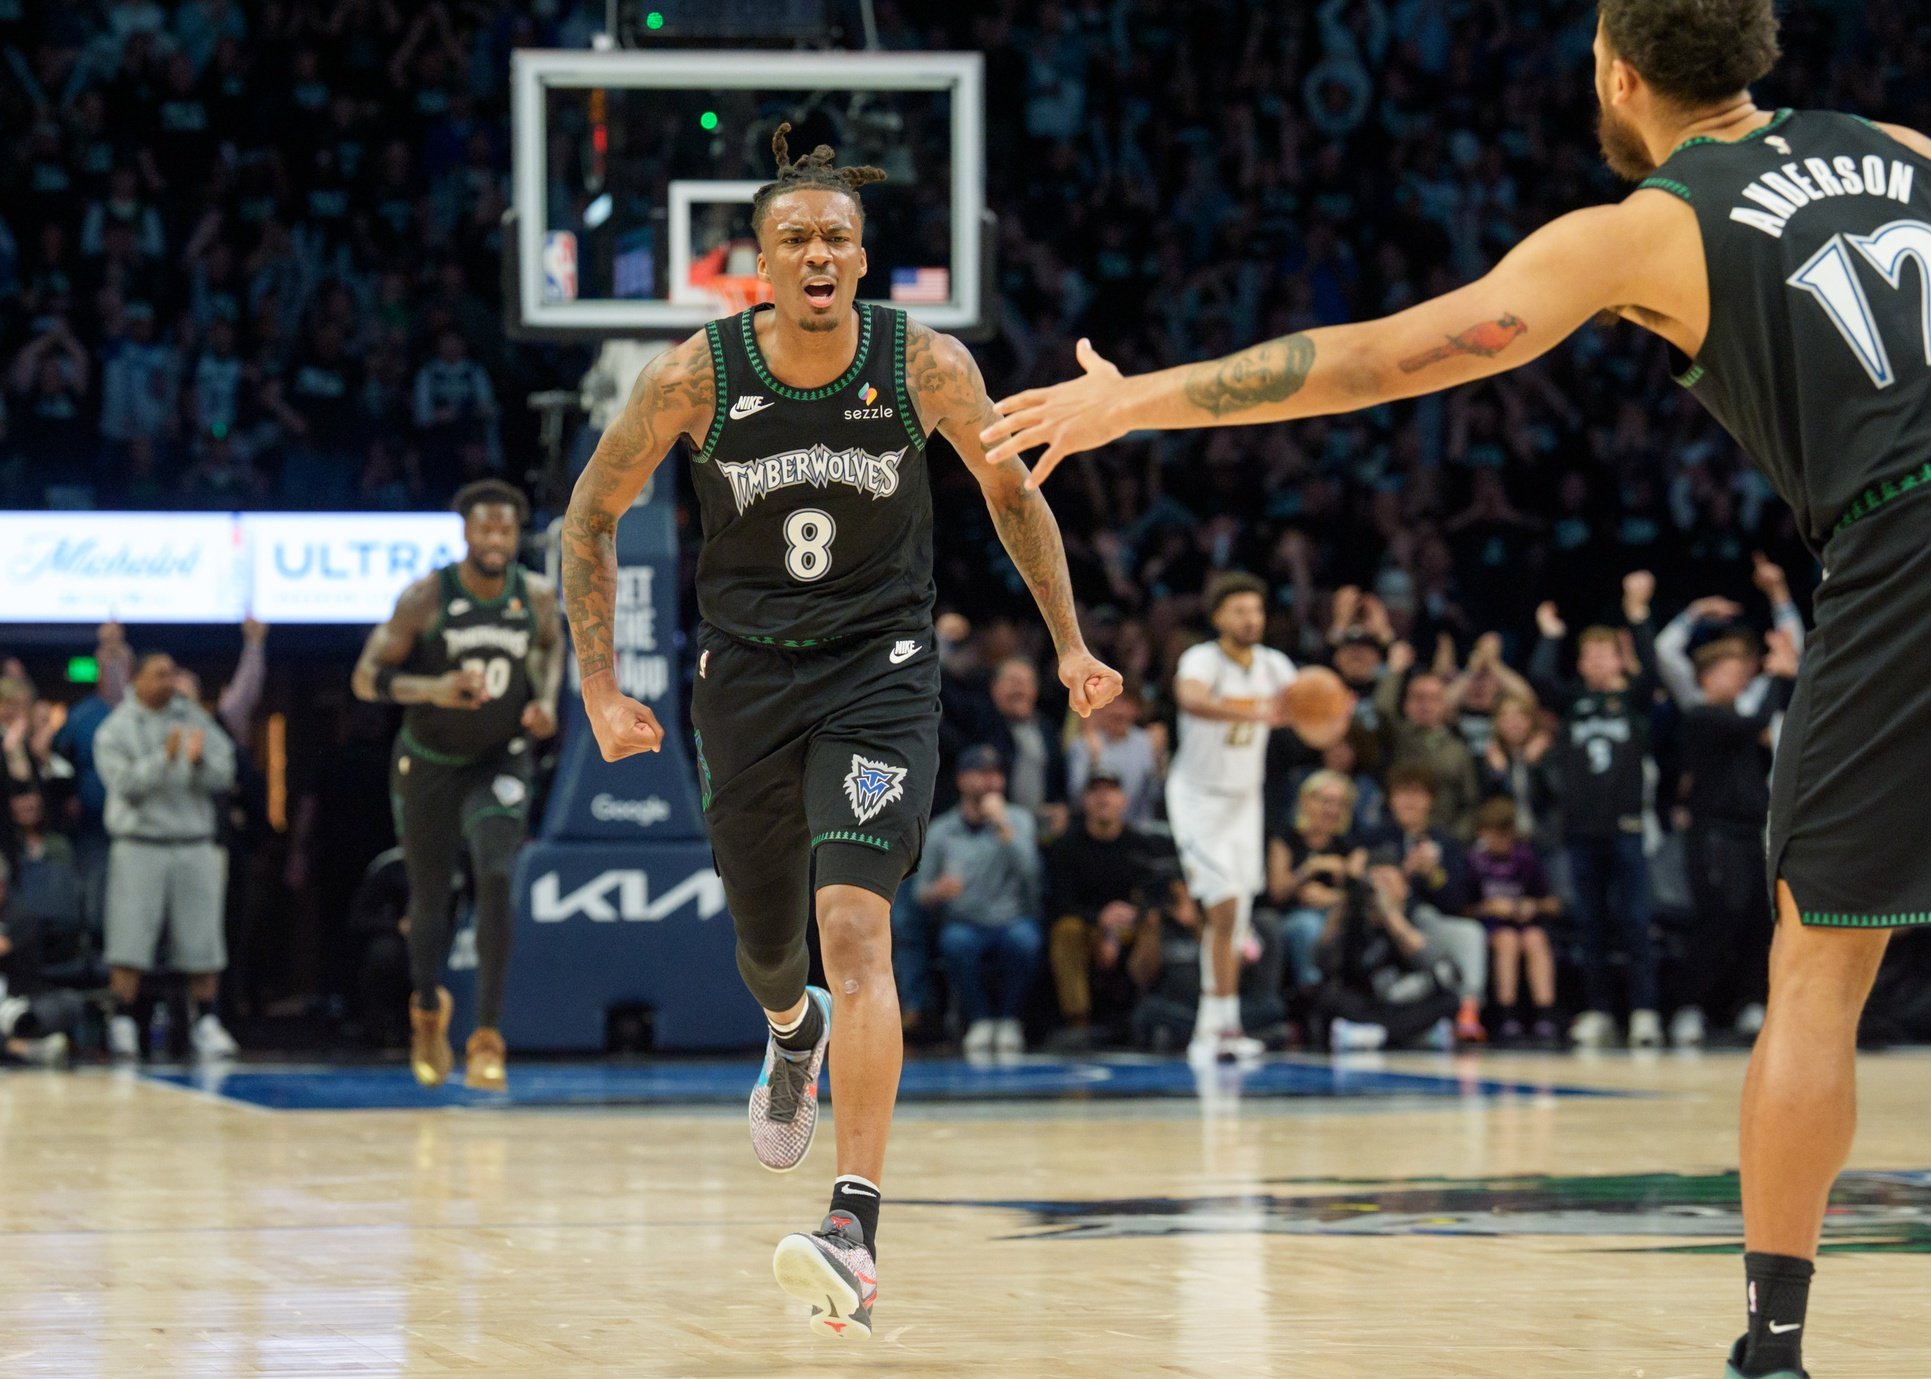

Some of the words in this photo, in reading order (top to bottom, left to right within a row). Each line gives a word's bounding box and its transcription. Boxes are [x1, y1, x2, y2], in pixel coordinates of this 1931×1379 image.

[1729, 155, 1914, 238] ANDERSON
[736, 395, 764, 410] NIKE
[844, 404, 893, 420] sezzle
[715, 443, 909, 516] TIMBERWOLVES
[783, 508, 836, 582] 8
[894, 640, 916, 655] NIKE
[590, 792, 671, 828] Google
[530, 869, 727, 923] KIA
